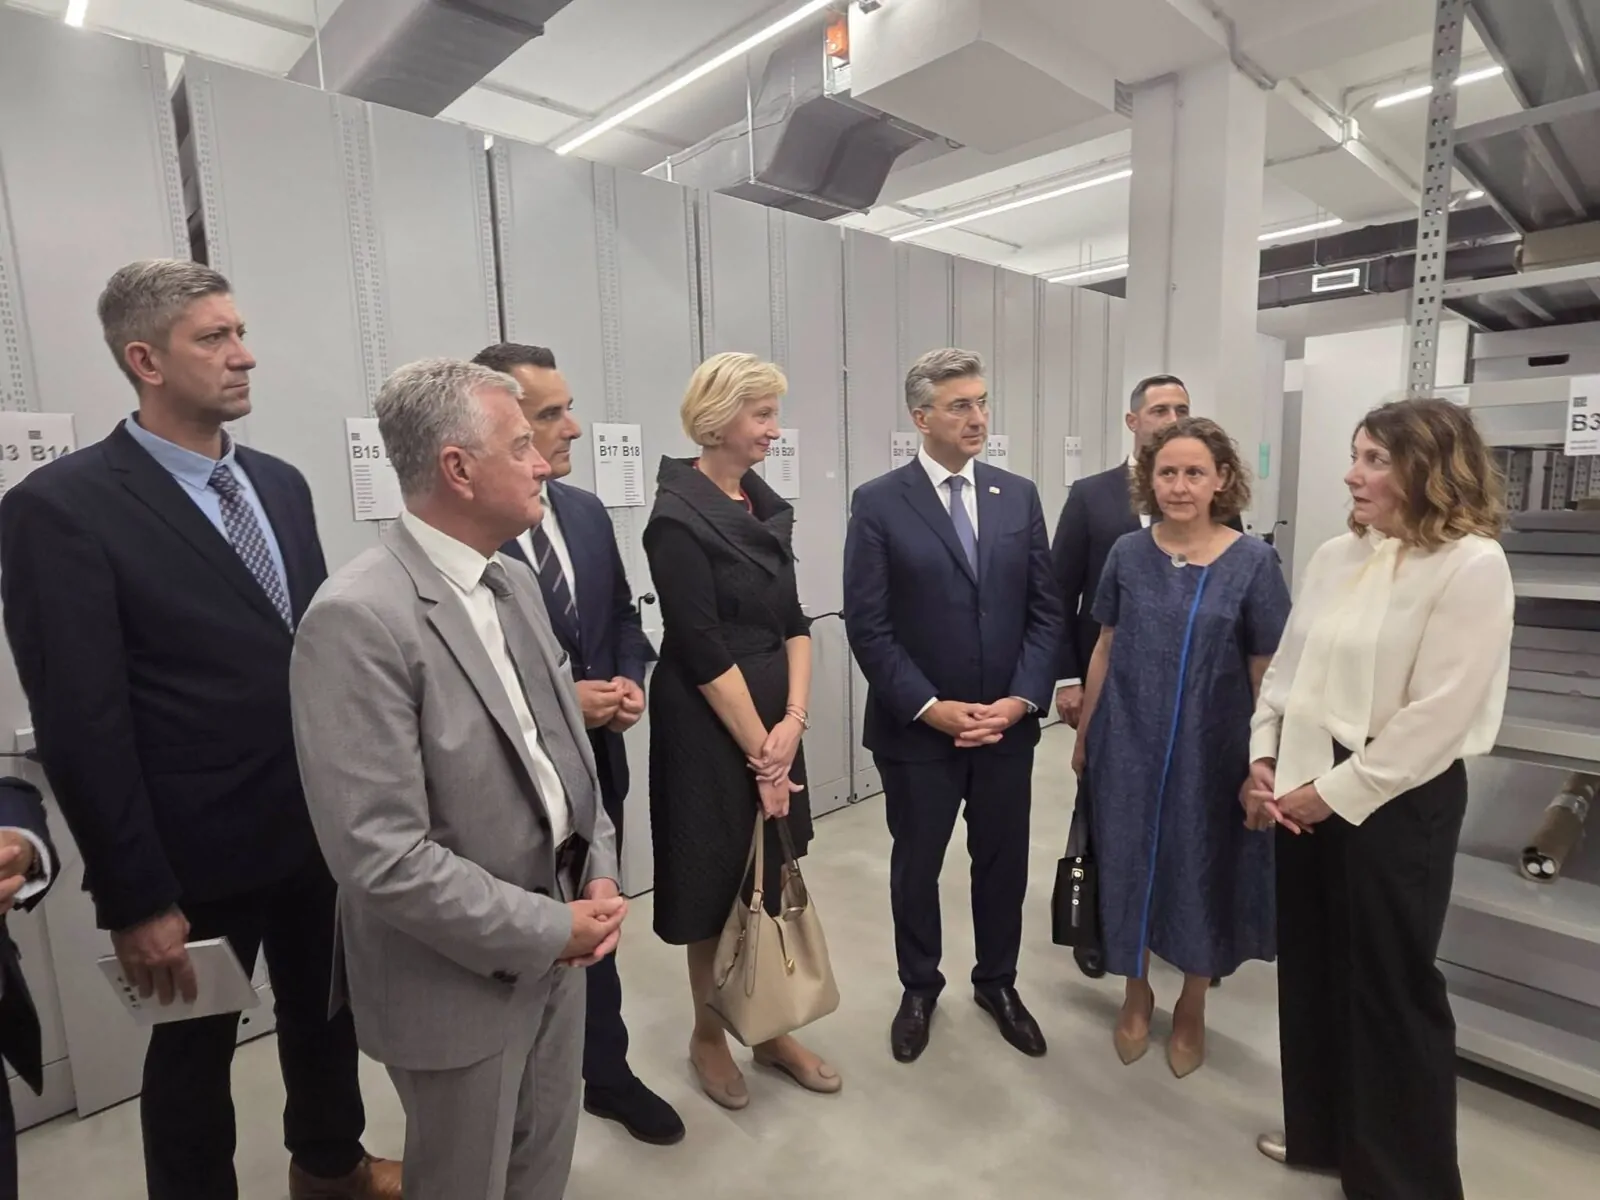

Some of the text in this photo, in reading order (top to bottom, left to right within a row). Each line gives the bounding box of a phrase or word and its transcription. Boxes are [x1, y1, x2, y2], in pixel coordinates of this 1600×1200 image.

[352, 445, 380, 459] B15
[600, 445, 640, 456] B17 B18
